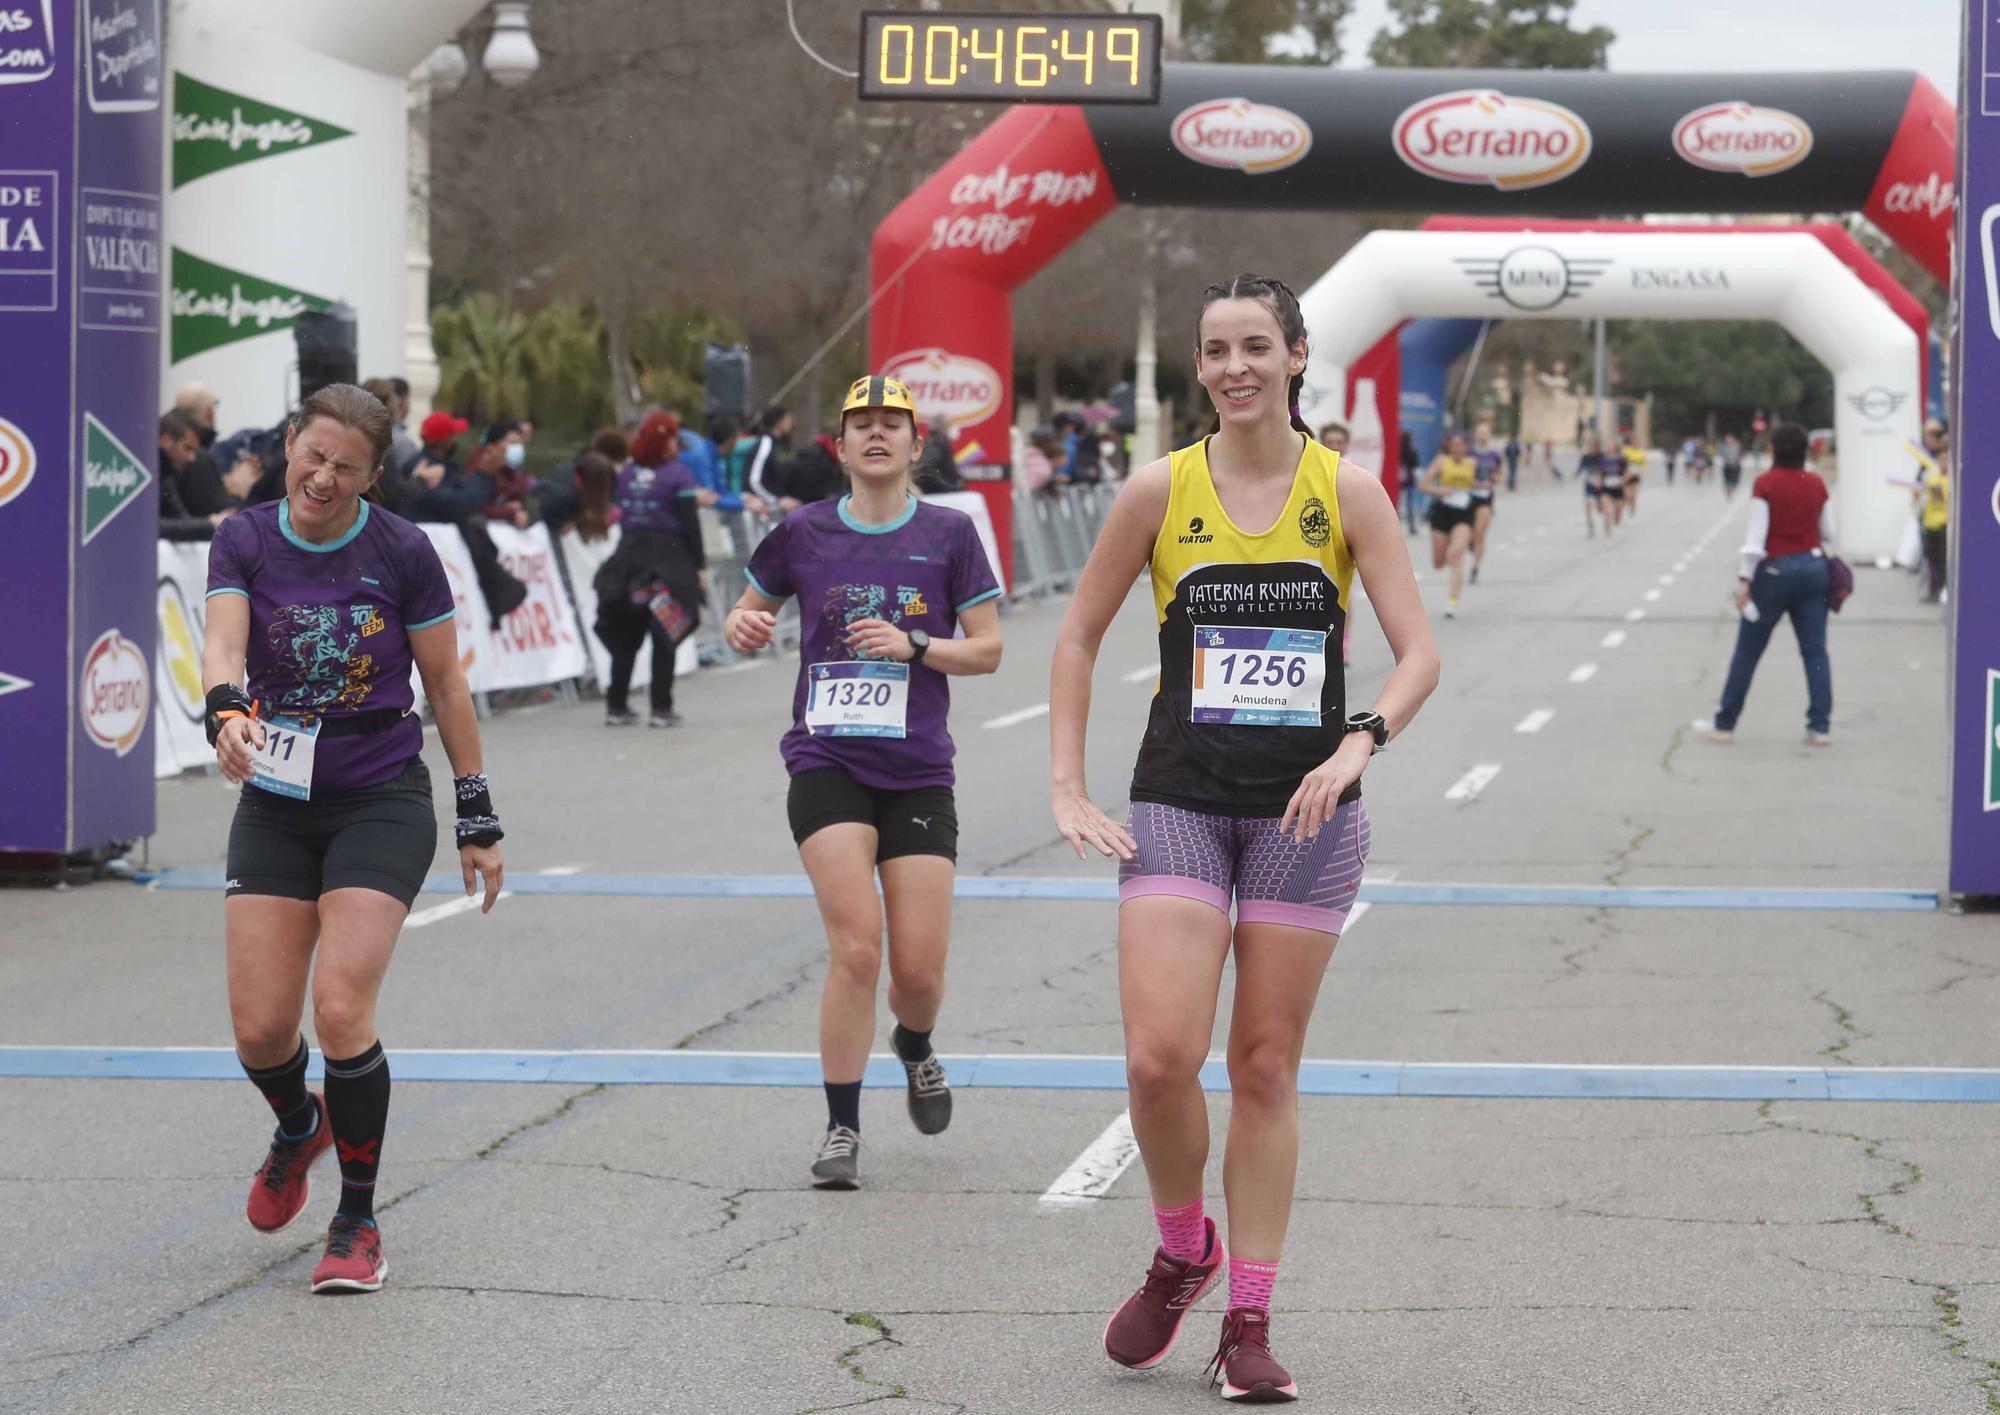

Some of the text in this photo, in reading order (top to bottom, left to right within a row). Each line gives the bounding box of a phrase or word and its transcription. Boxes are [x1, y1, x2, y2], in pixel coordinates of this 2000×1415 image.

[880, 25, 1139, 87] 00:46:49
[1186, 119, 1296, 150] Serrano
[1418, 118, 1569, 157] Serrano
[1692, 127, 1797, 152] Serrano
[0, 187, 42, 206] DE
[1631, 267, 1730, 289] ENGASA
[1178, 534, 1213, 544] VIATOR
[1189, 584, 1254, 604] PATERNA
[364, 620, 382, 635] FEM
[1220, 653, 1307, 687] 1256
[91, 669, 141, 715] Serrano
[827, 682, 891, 706] 1320
[1232, 694, 1287, 706] Almudena
